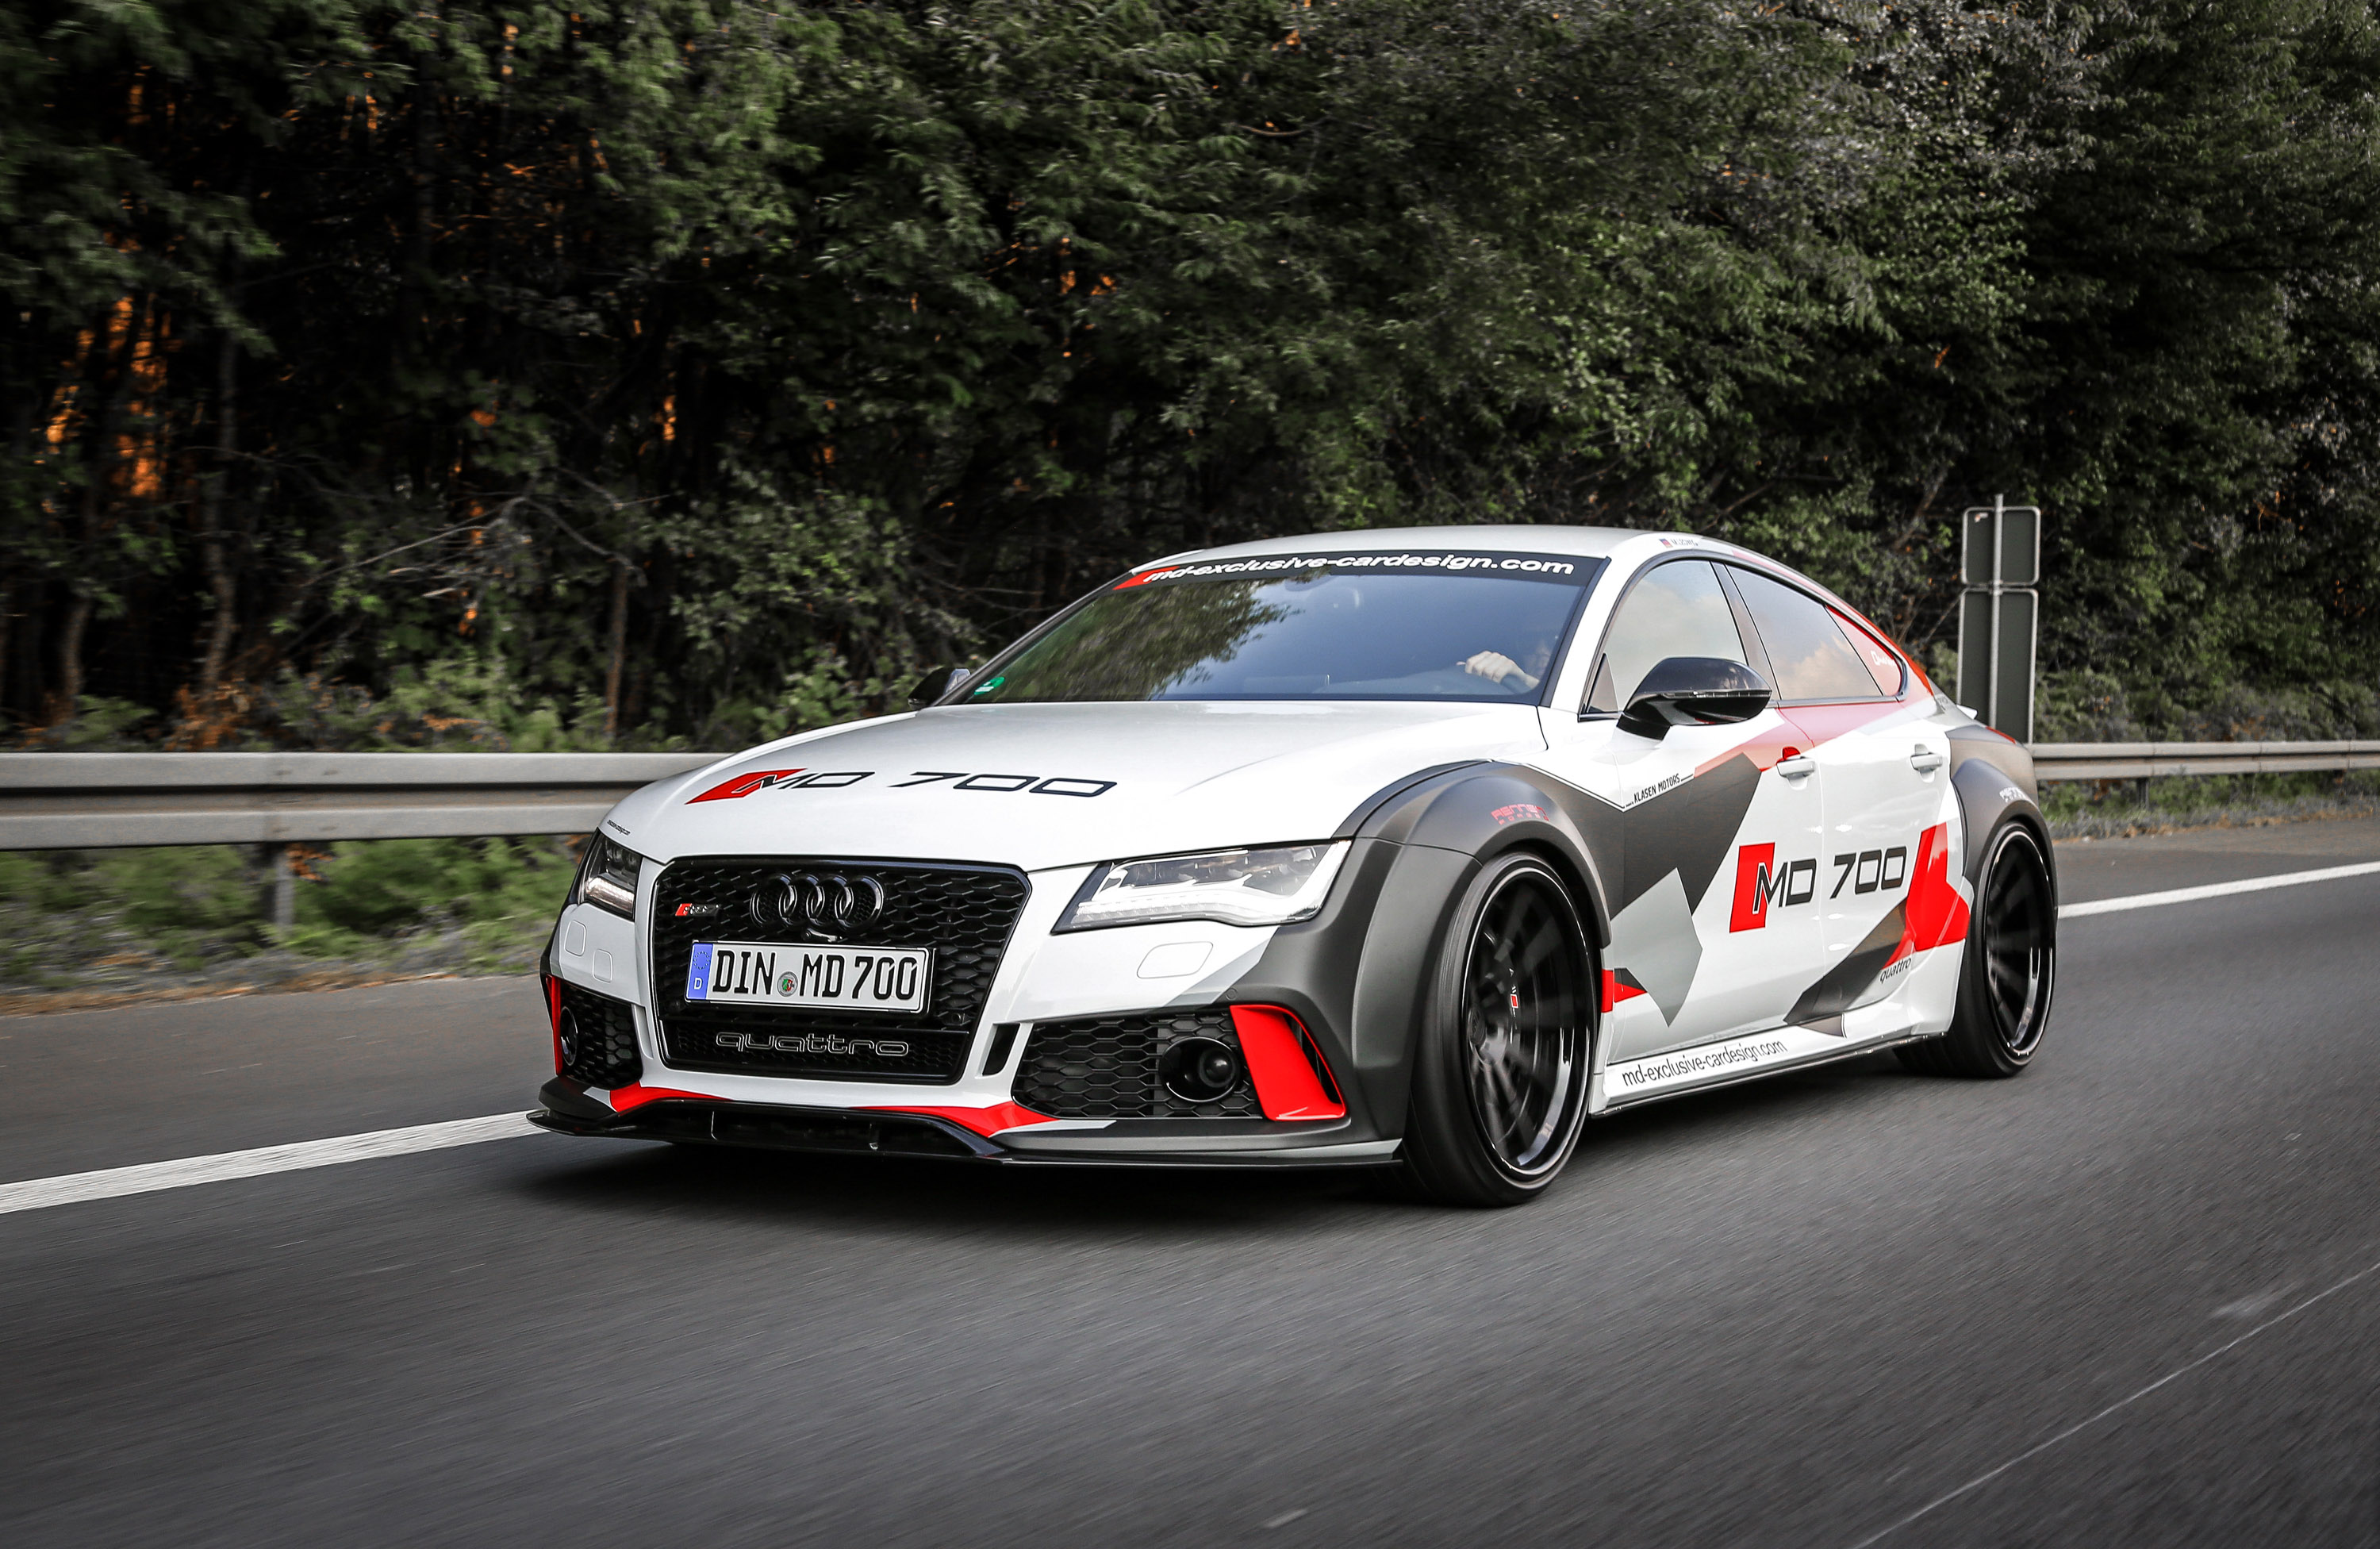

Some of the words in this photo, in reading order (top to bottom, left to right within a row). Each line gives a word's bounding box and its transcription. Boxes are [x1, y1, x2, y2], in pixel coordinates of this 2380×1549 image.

[1142, 553, 1575, 584] md-exclusive-cardesign.com
[731, 771, 875, 794] MD
[887, 771, 1118, 798] 700
[1633, 784, 1656, 804] KLASEN
[1657, 773, 1680, 793] MOTORS
[1752, 857, 1817, 913] MD
[1829, 845, 1907, 900] 700
[693, 977, 703, 990] D
[712, 949, 776, 996] DIN
[799, 953, 846, 998] MD
[851, 955, 918, 1001] 700
[1879, 957, 1912, 985] quattro
[715, 1031, 910, 1057] quattro
[1622, 1040, 1788, 1087] md-exclusive-cardesign.com
